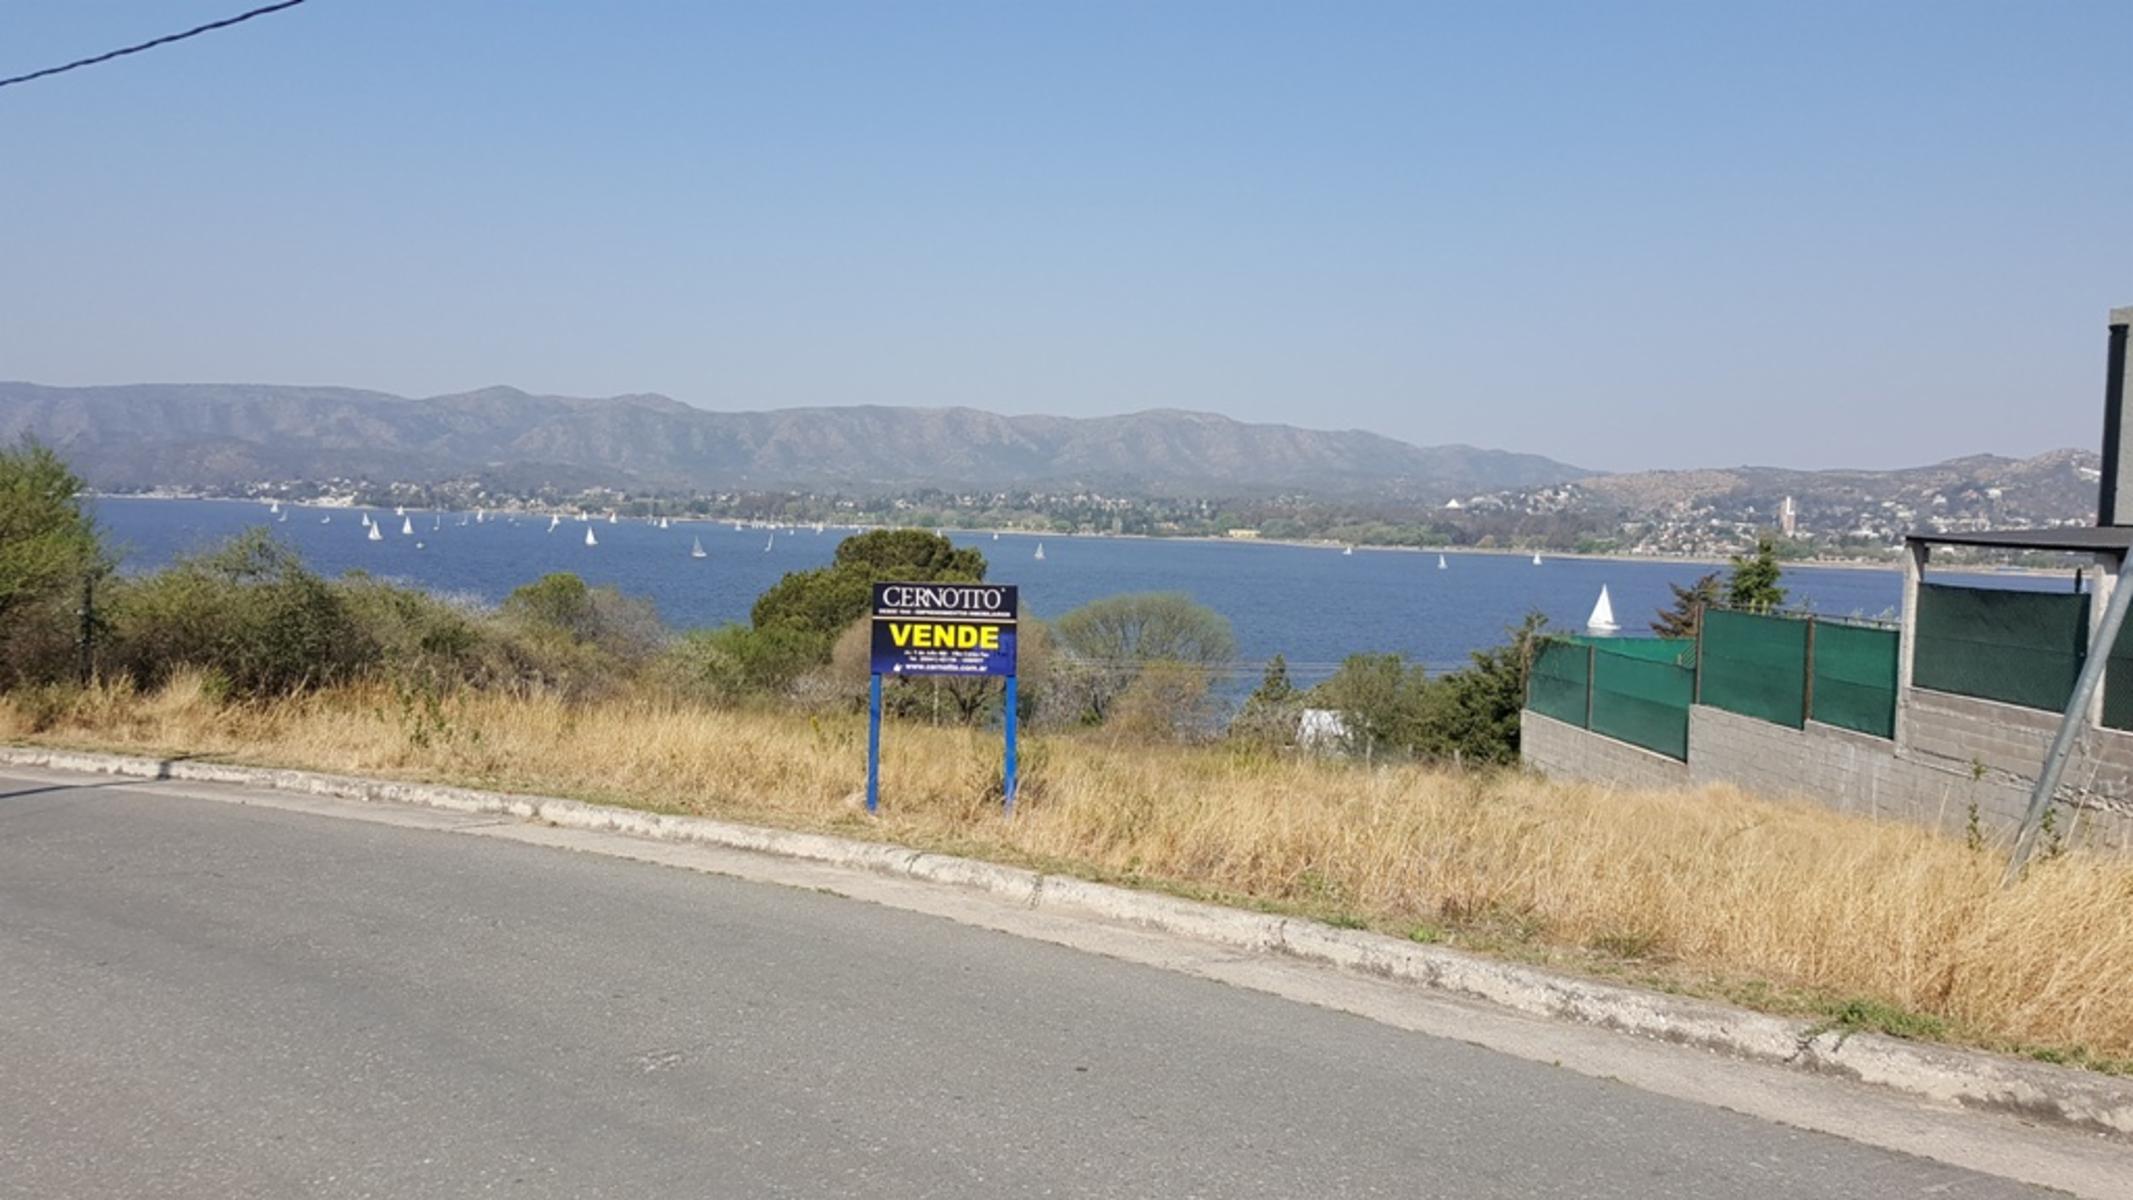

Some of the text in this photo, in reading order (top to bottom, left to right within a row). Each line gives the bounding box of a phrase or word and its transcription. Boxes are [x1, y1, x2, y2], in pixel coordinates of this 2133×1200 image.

[883, 587, 1001, 609] CERNOTTO
[889, 623, 999, 649] VENDE
[905, 663, 988, 672] www.cernotto.com.ar
